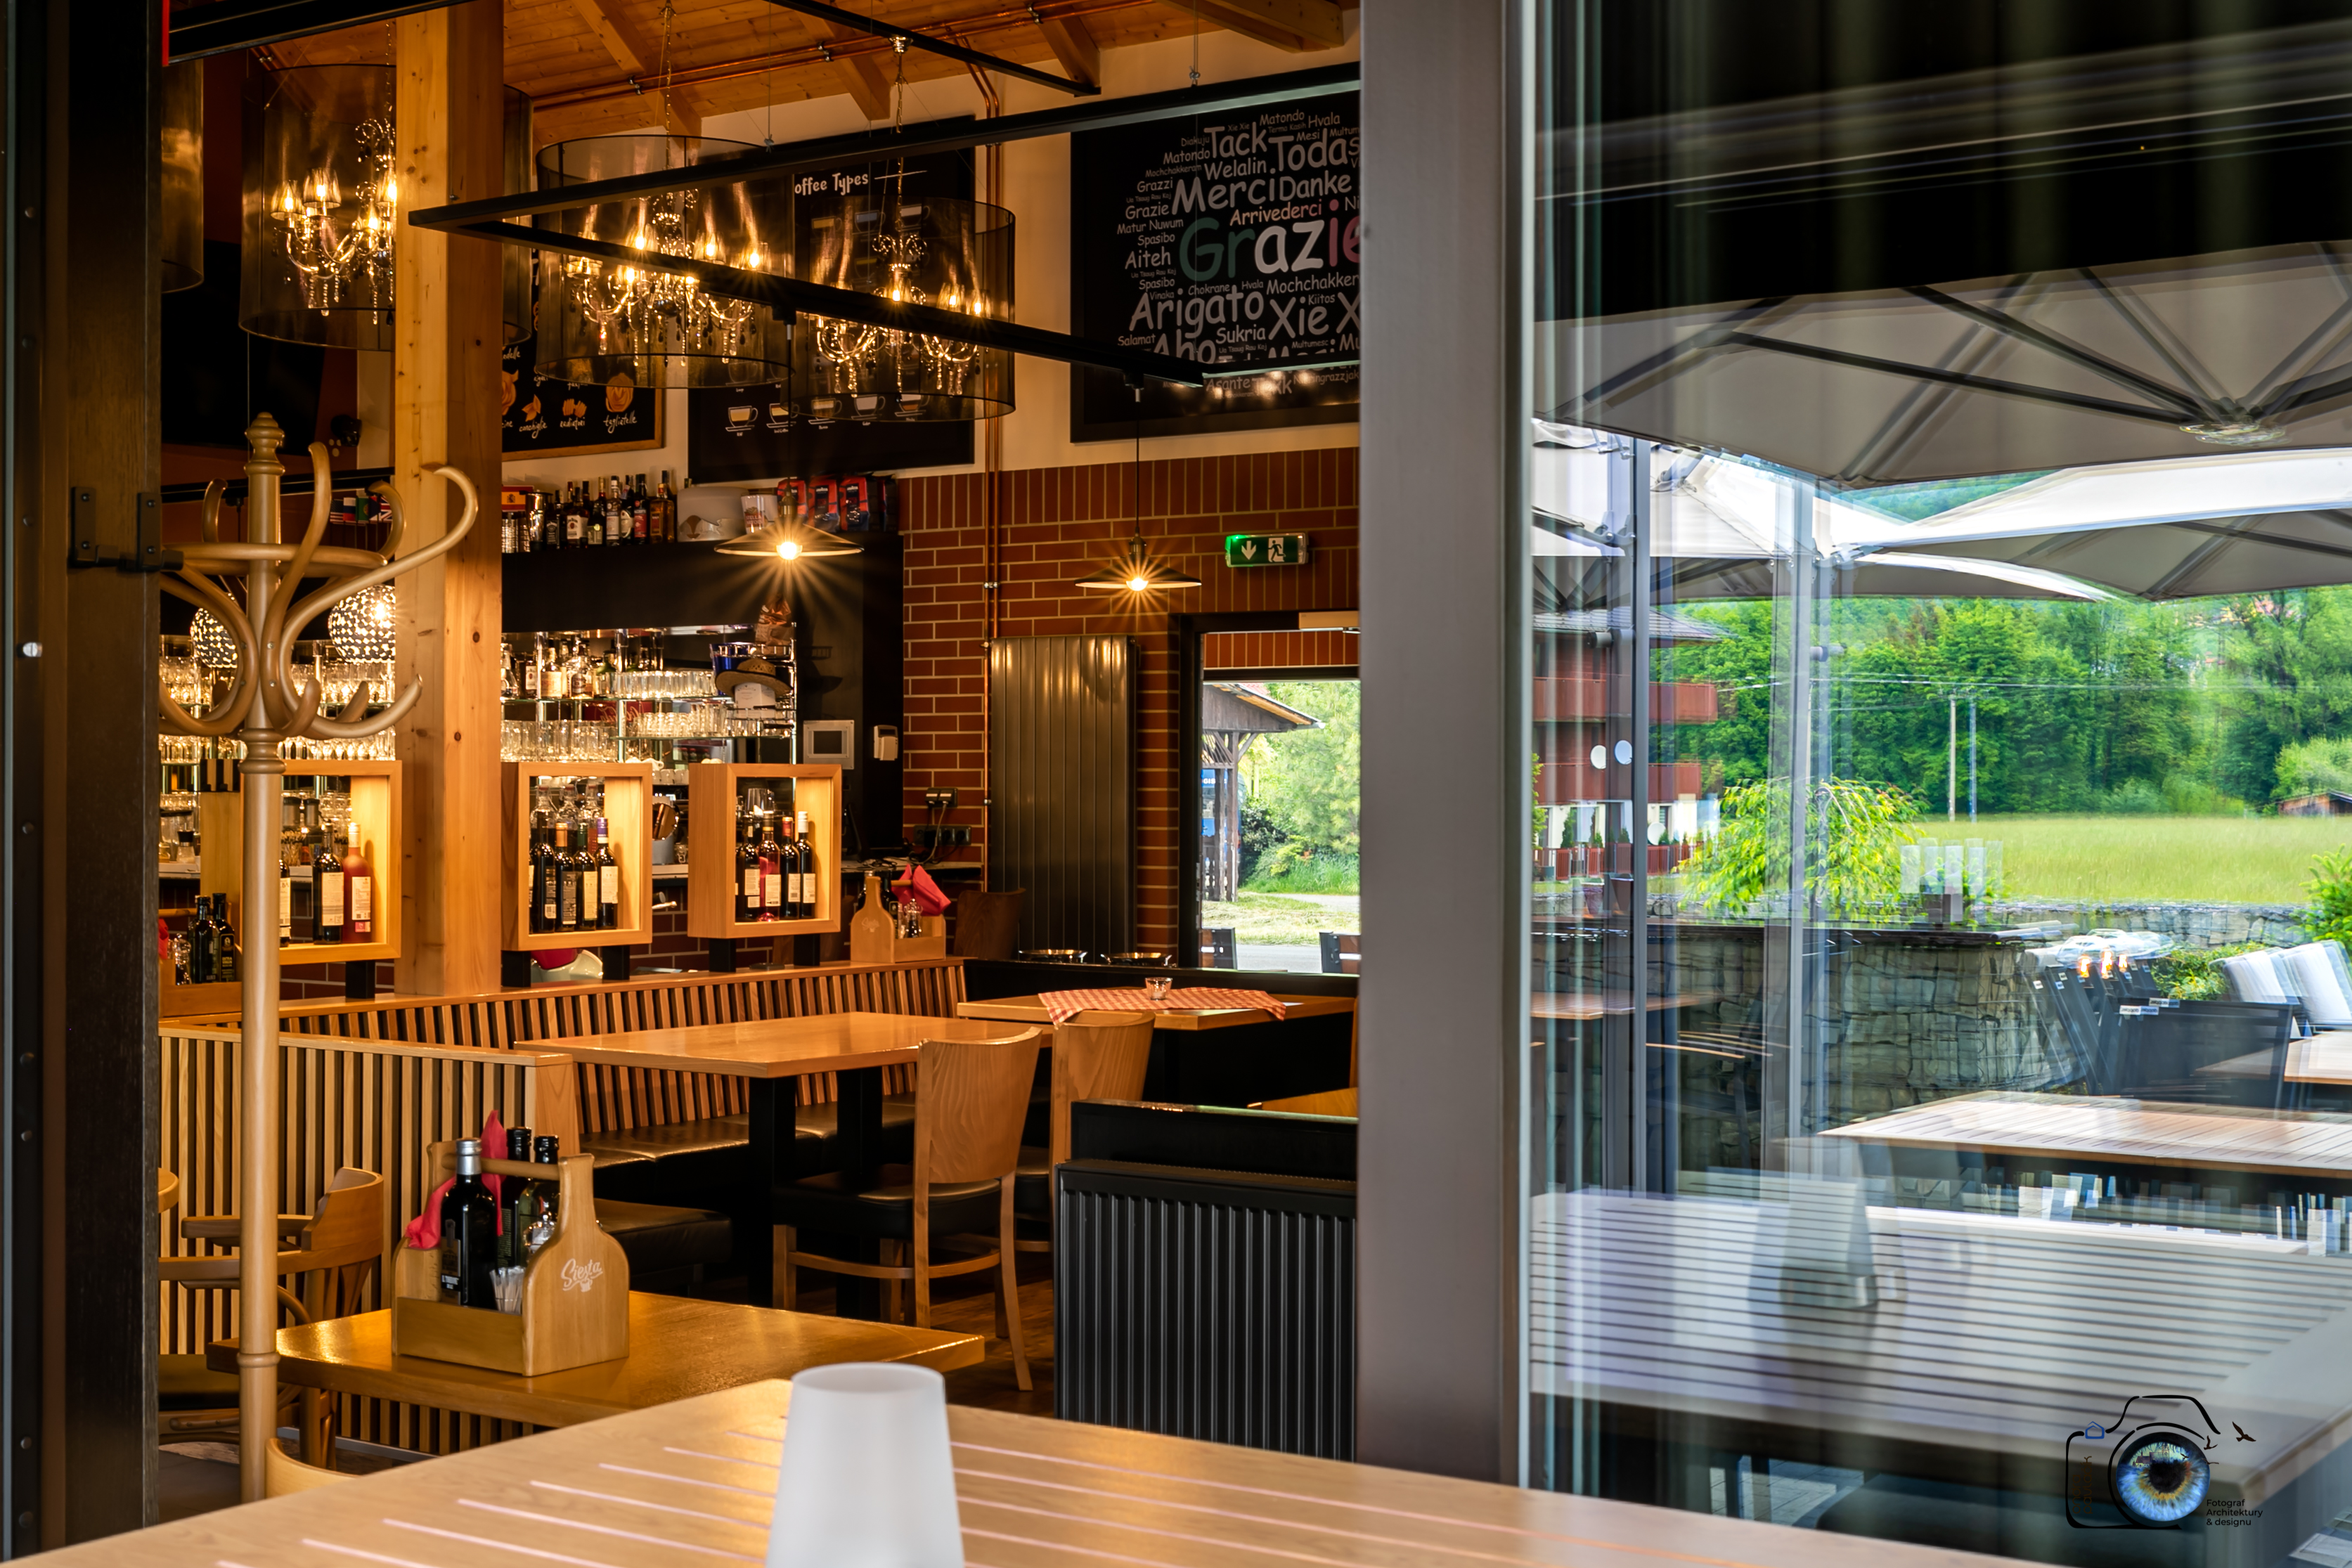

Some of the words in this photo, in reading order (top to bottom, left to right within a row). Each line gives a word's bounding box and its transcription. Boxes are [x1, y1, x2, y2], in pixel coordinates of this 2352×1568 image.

[1259, 108, 1305, 127] Matondo
[1307, 111, 1340, 129] Hvala
[1203, 121, 1267, 159] Tack
[1296, 129, 1320, 142] Mesi
[1163, 147, 1210, 165] Matondo
[1203, 156, 1267, 181] Welalin
[832, 172, 869, 196] Types
[1137, 176, 1173, 193] Grazzi
[1171, 168, 1275, 216] Merci
[1279, 169, 1352, 202] Danke
[1125, 201, 1170, 220] Grazie
[1229, 198, 1322, 226] Arrivederci
[1116, 223, 1146, 235] Matur
[1149, 219, 1184, 231] Nuwum
[1137, 231, 1175, 249] Spasibo
[1125, 245, 1172, 270] Aiteh
[1138, 276, 1175, 292] Spasibo
[1188, 283, 1231, 296] Chokrane
[1241, 278, 1264, 290] Hvala
[1149, 290, 1175, 301] Vinaka
[1307, 294, 1336, 306] Kiitos
[1129, 284, 1264, 339] Arigato
[1268, 296, 1329, 341] Xie
[1117, 333, 1156, 346] Salamat
[1215, 323, 1266, 344] Sukria
[1206, 377, 1251, 391] Asante
[603, 410, 638, 434] tagliatelle
[560, 1257, 603, 1288] Siesta
